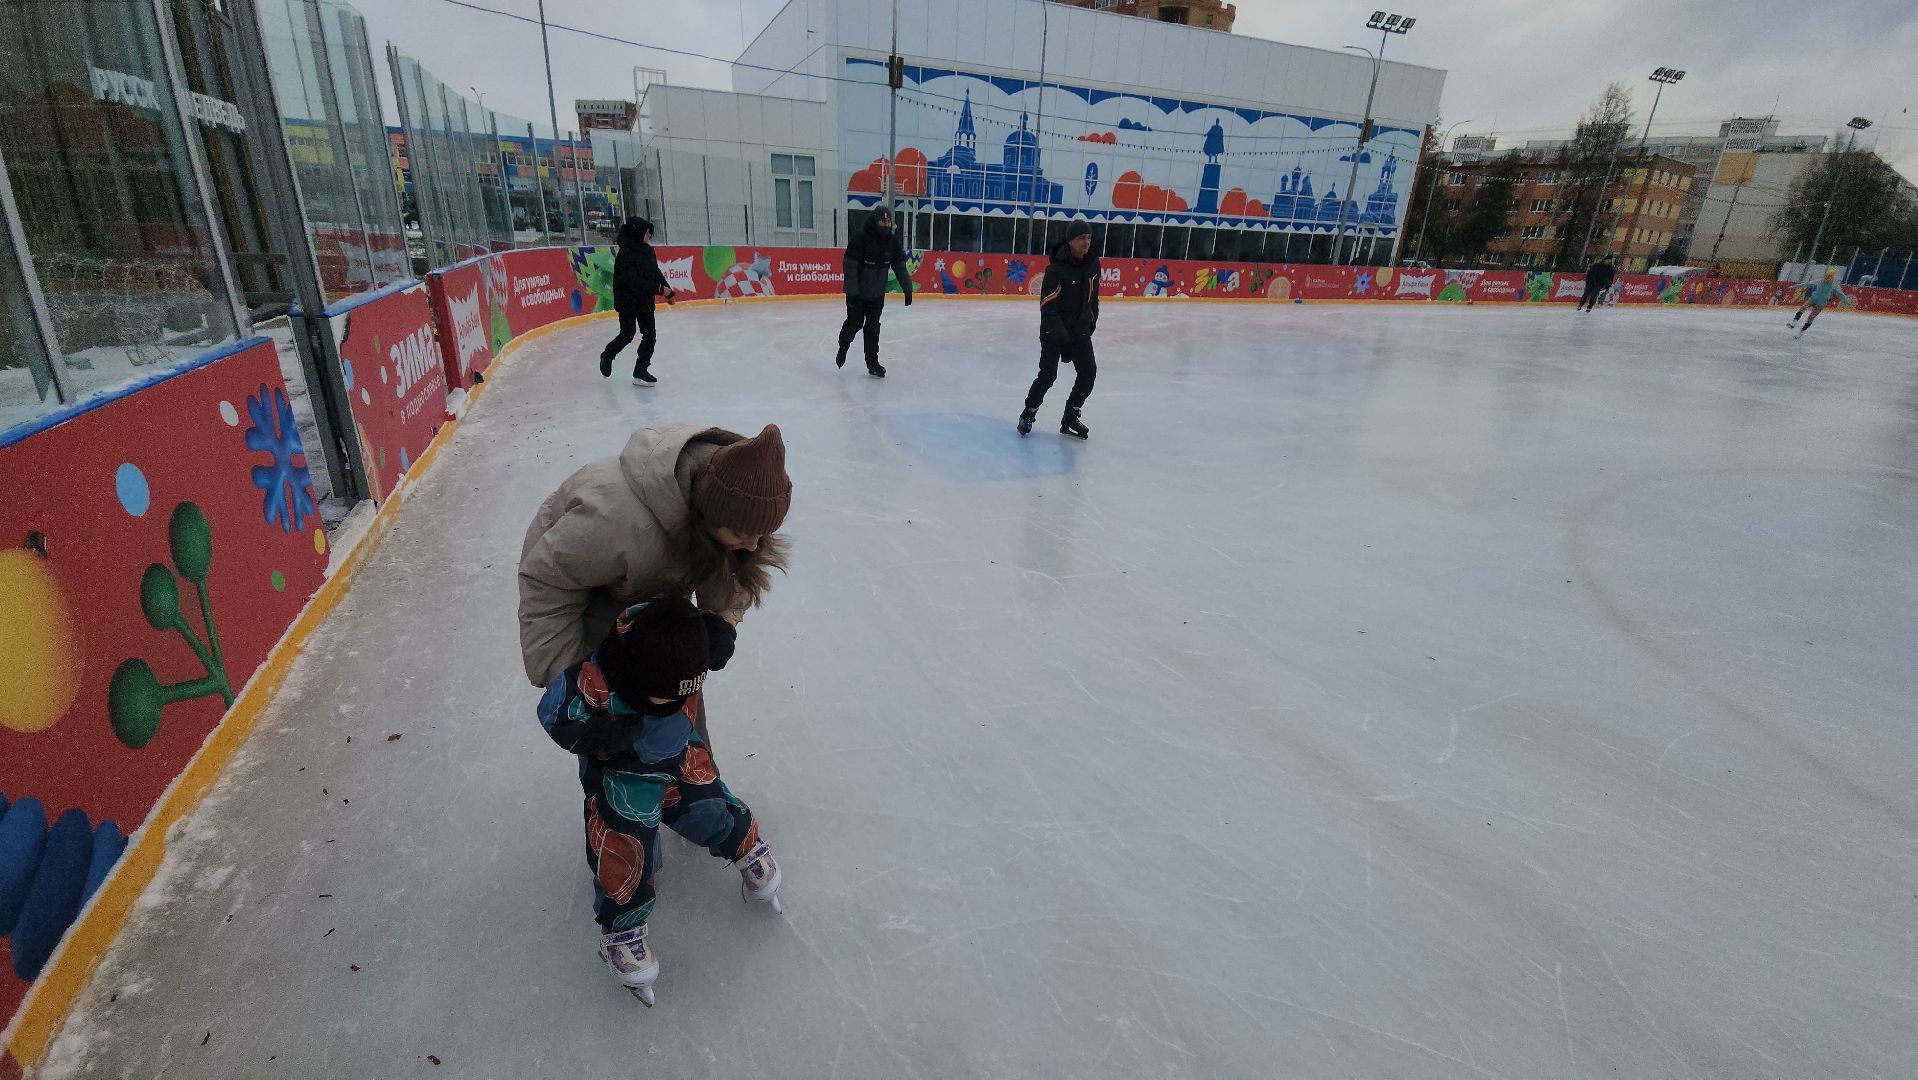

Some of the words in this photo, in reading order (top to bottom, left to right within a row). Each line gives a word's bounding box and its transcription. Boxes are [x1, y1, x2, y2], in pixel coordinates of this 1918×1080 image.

[778, 260, 797, 273] Для
[799, 263, 831, 273] умных
[669, 269, 688, 279] Банк
[787, 273, 794, 282] и
[513, 276, 526, 297] Для
[526, 273, 550, 293] умных
[520, 297, 527, 308] и
[526, 287, 566, 307] свободных
